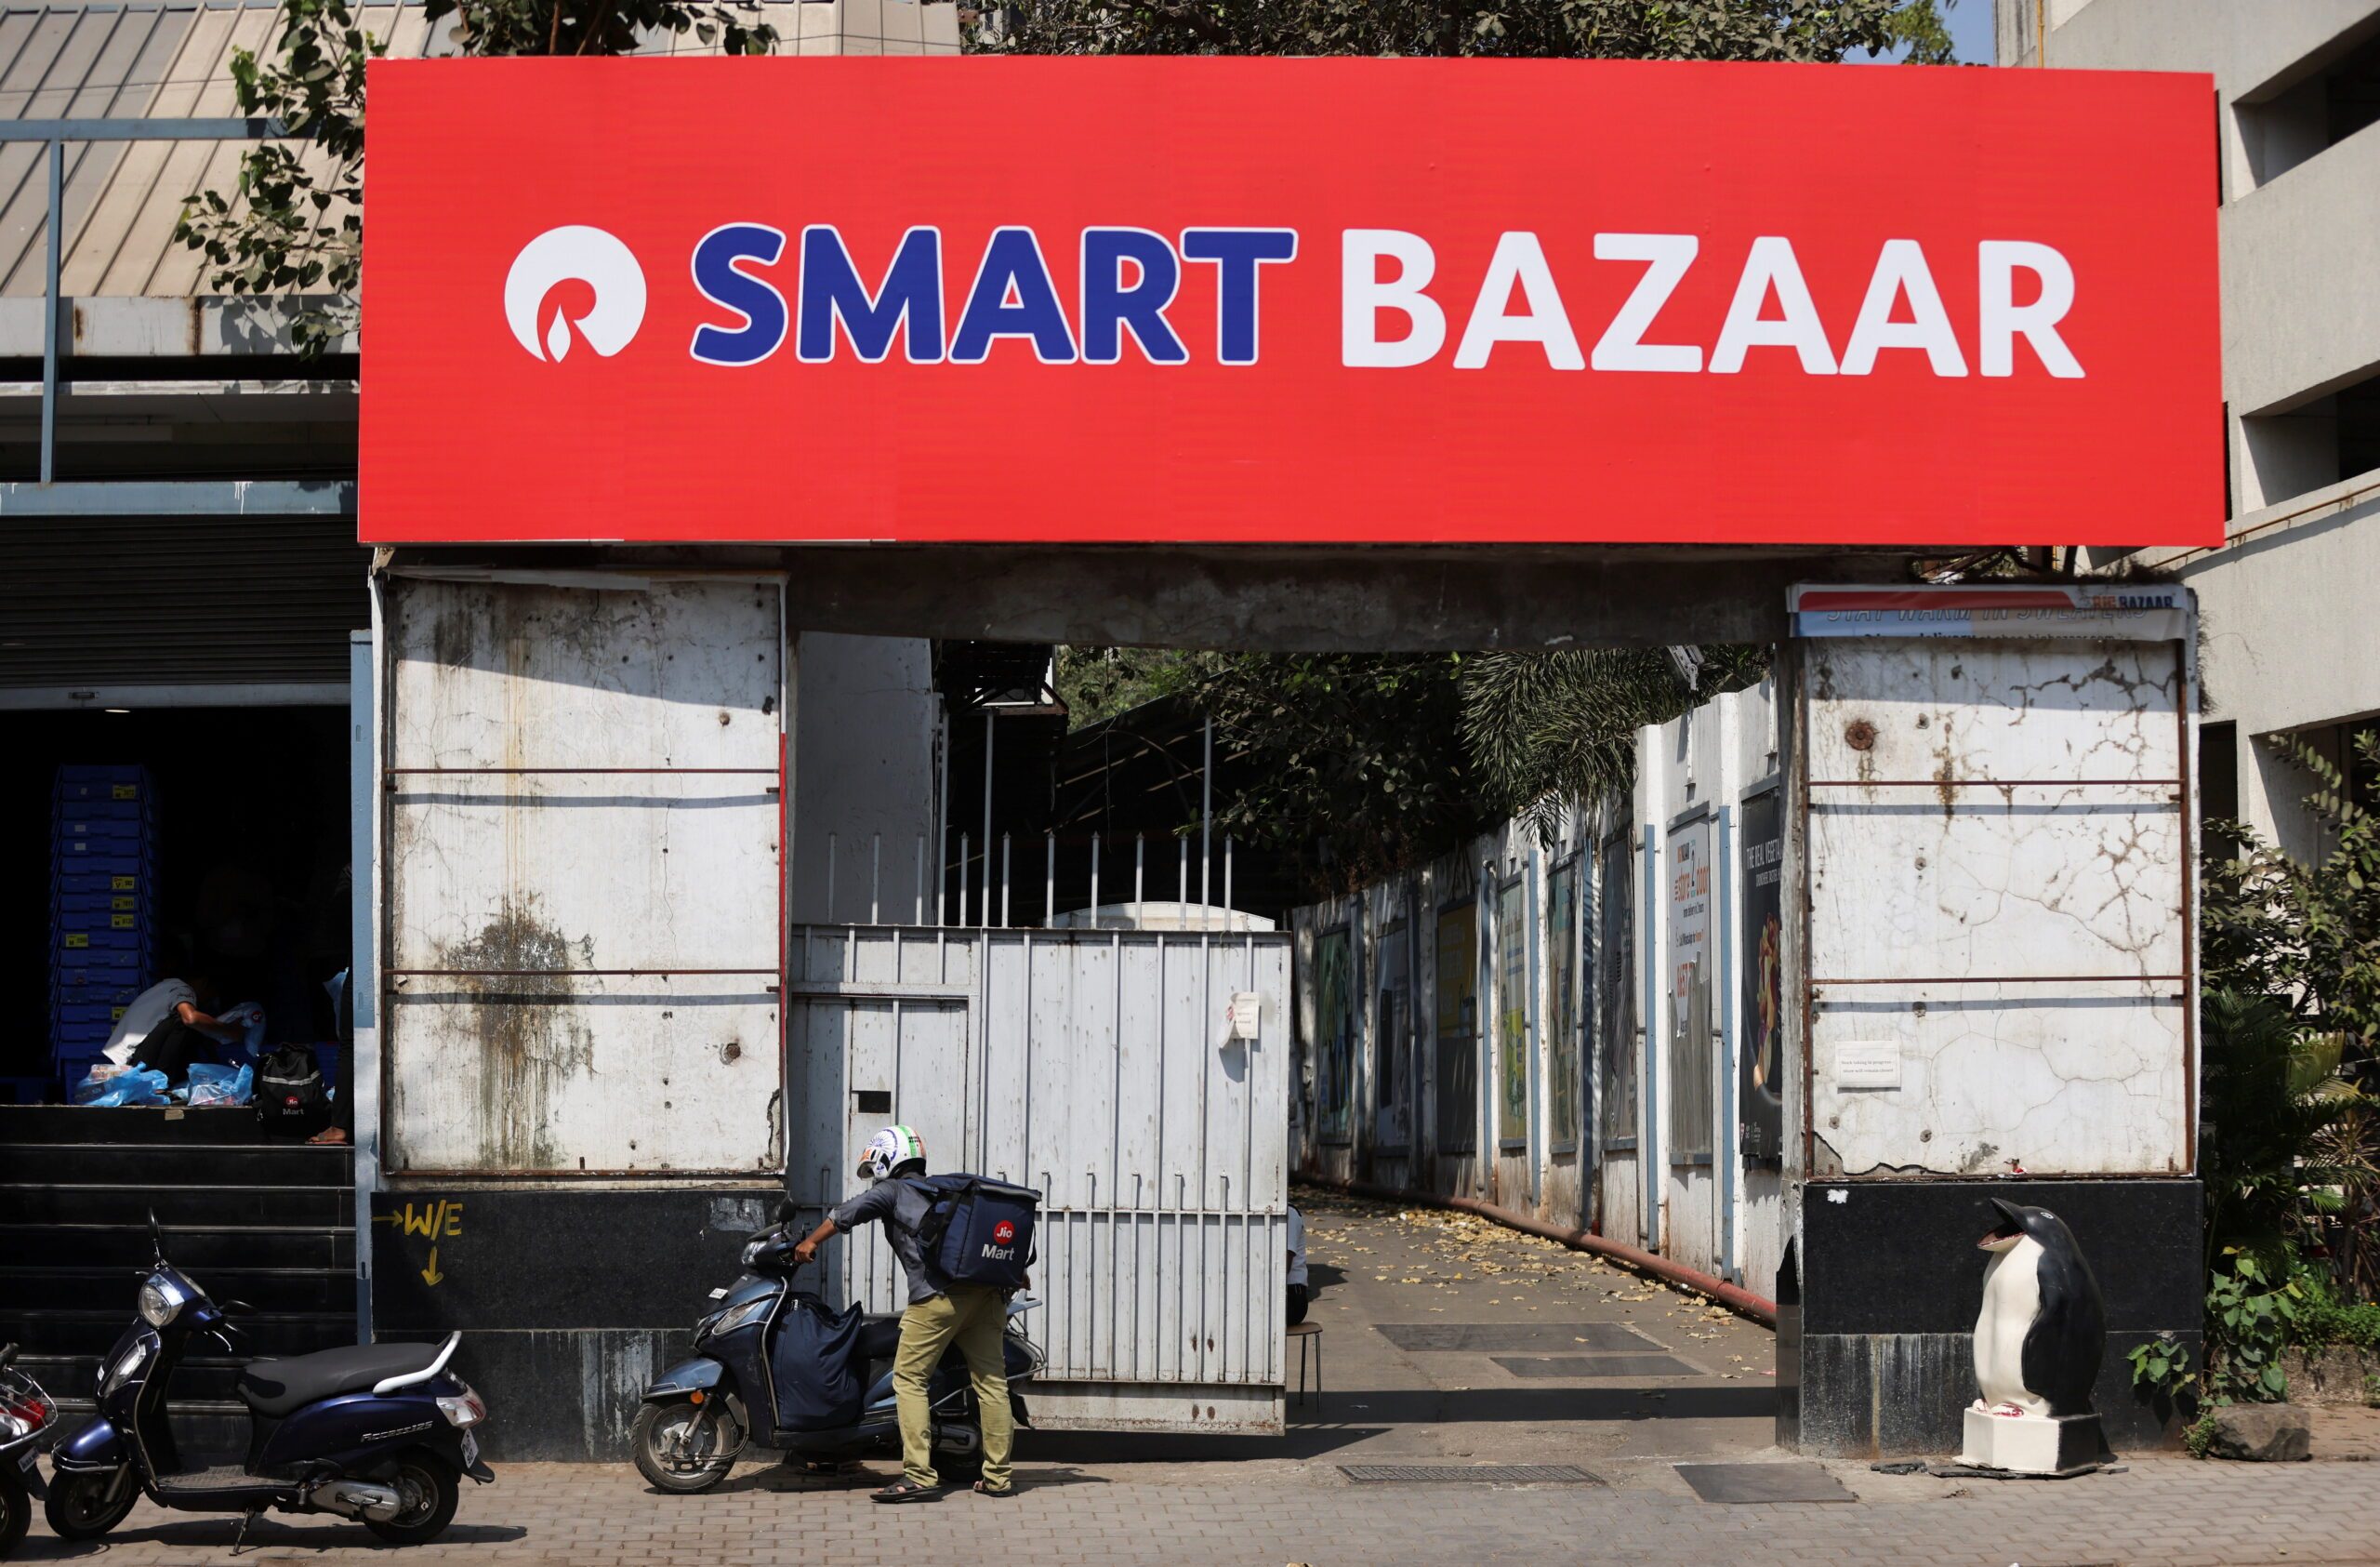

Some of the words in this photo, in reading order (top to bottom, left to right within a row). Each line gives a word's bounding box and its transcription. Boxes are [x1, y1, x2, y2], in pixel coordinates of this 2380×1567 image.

[690, 221, 1298, 367] SMART
[1342, 229, 2085, 378] BAZAAR
[2119, 595, 2174, 608] BAZAAR
[1746, 845, 1754, 870] THE
[404, 1199, 464, 1242] W/E
[996, 1227, 1012, 1239] Jio
[981, 1243, 1015, 1261] Mart
